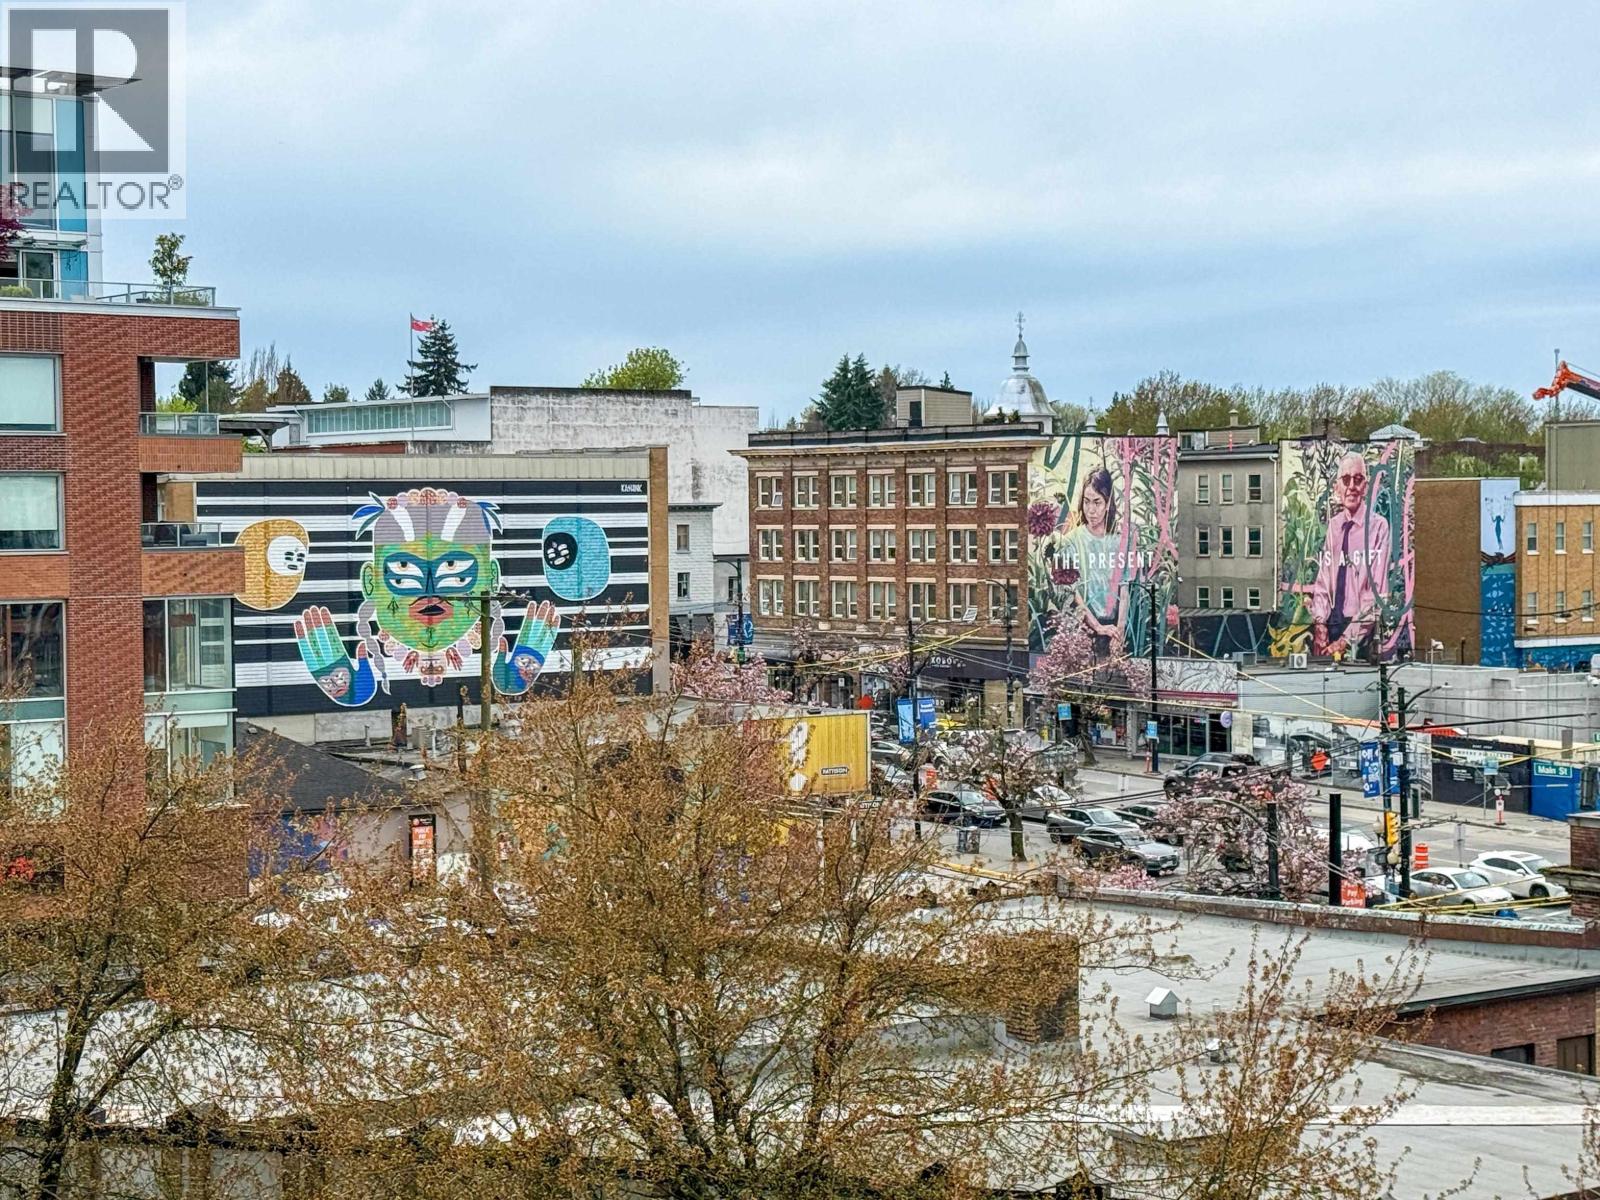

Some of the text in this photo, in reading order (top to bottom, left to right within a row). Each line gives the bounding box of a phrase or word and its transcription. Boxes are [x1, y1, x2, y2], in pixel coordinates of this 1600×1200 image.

[1053, 551, 1154, 570] THE PRESENT
[1319, 549, 1383, 567] IS A GIFT
[1537, 765, 1568, 776] Main St
